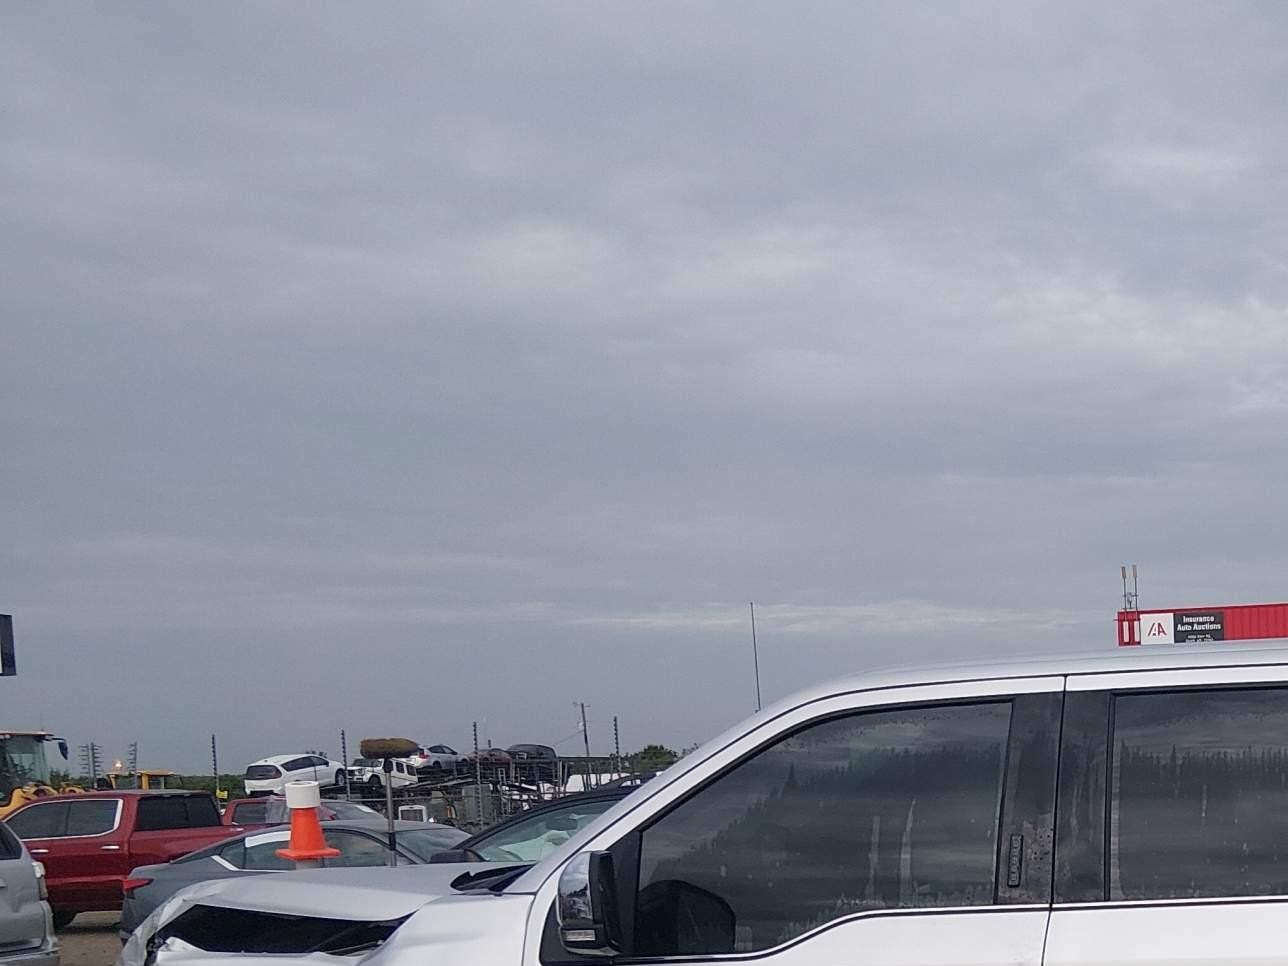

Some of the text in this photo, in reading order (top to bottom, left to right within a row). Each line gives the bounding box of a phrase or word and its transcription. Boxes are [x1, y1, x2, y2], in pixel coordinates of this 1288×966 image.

[1183, 615, 1215, 623] Insurance
[1176, 622, 1222, 631] Auto Auctions
